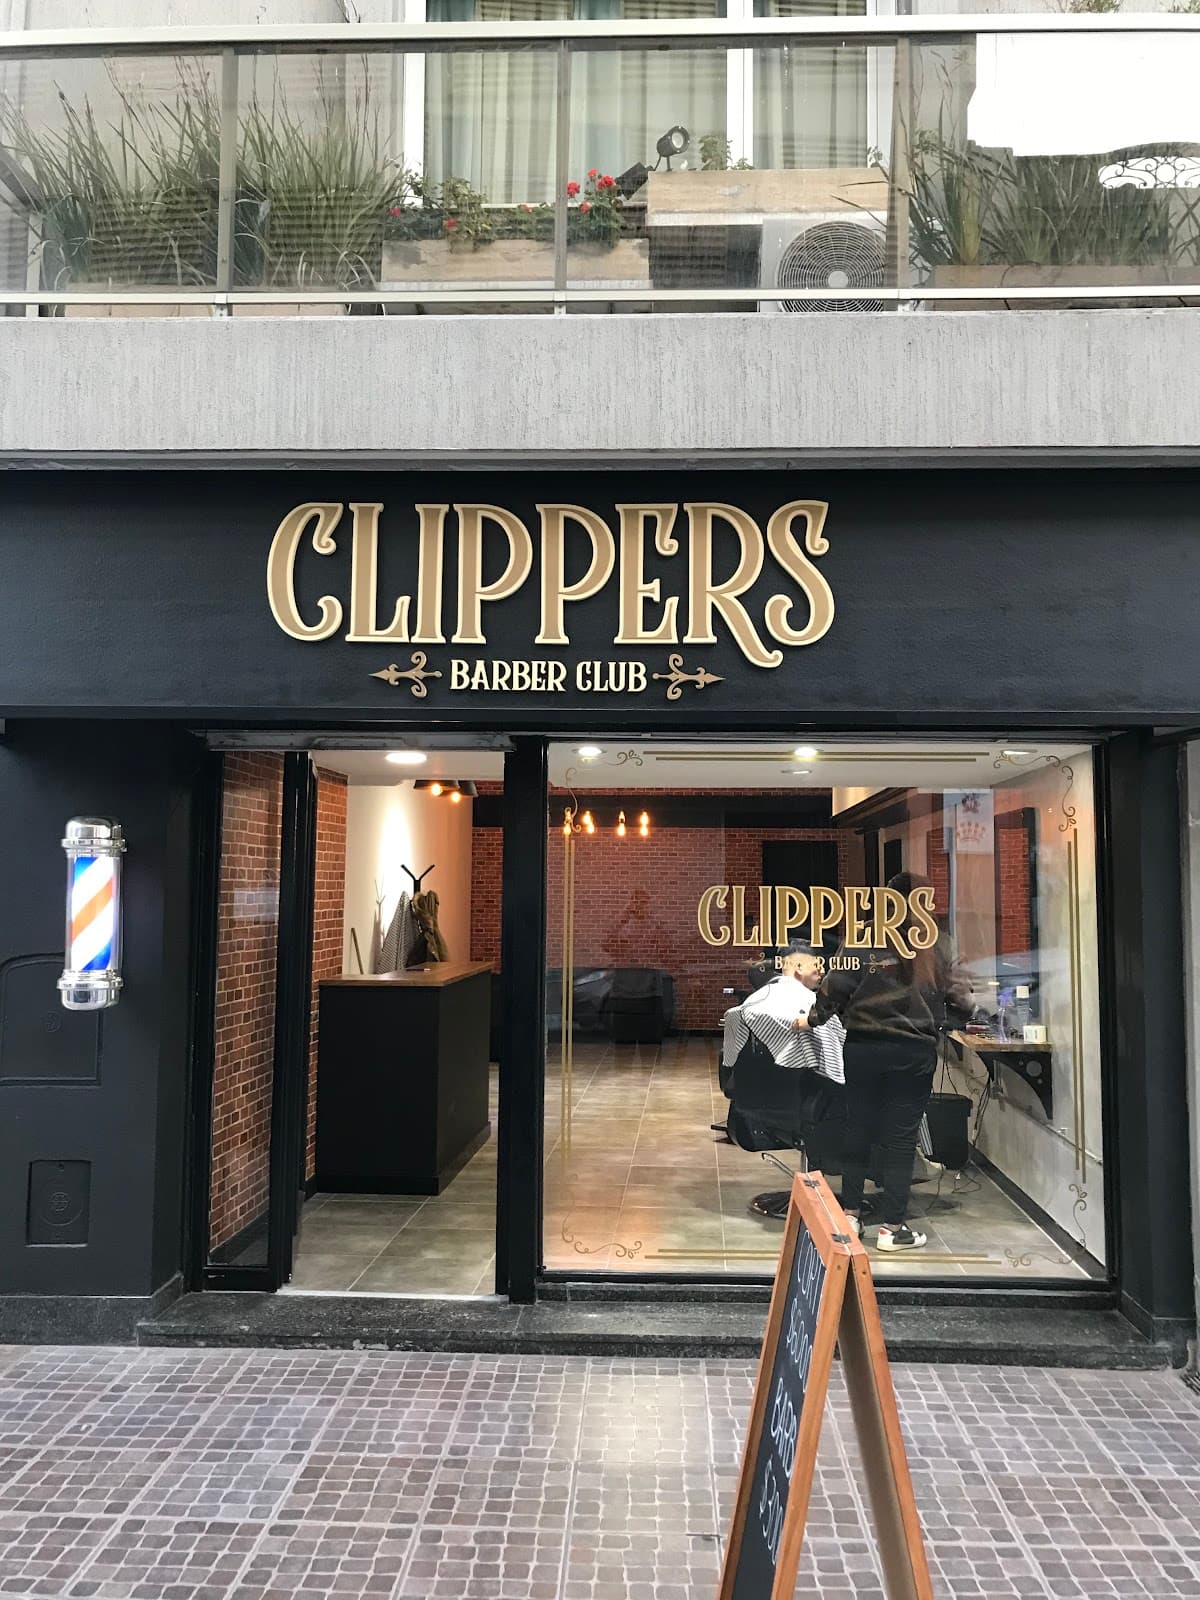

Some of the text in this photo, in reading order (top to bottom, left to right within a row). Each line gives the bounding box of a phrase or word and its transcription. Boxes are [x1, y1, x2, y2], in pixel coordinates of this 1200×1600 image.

[266, 499, 836, 669] CLIPPERS
[450, 659, 648, 692] BARBER CLUB
[698, 885, 939, 960] CLIPPERS
[828, 956, 861, 971] CLUB
[797, 1229, 827, 1328] CORT
